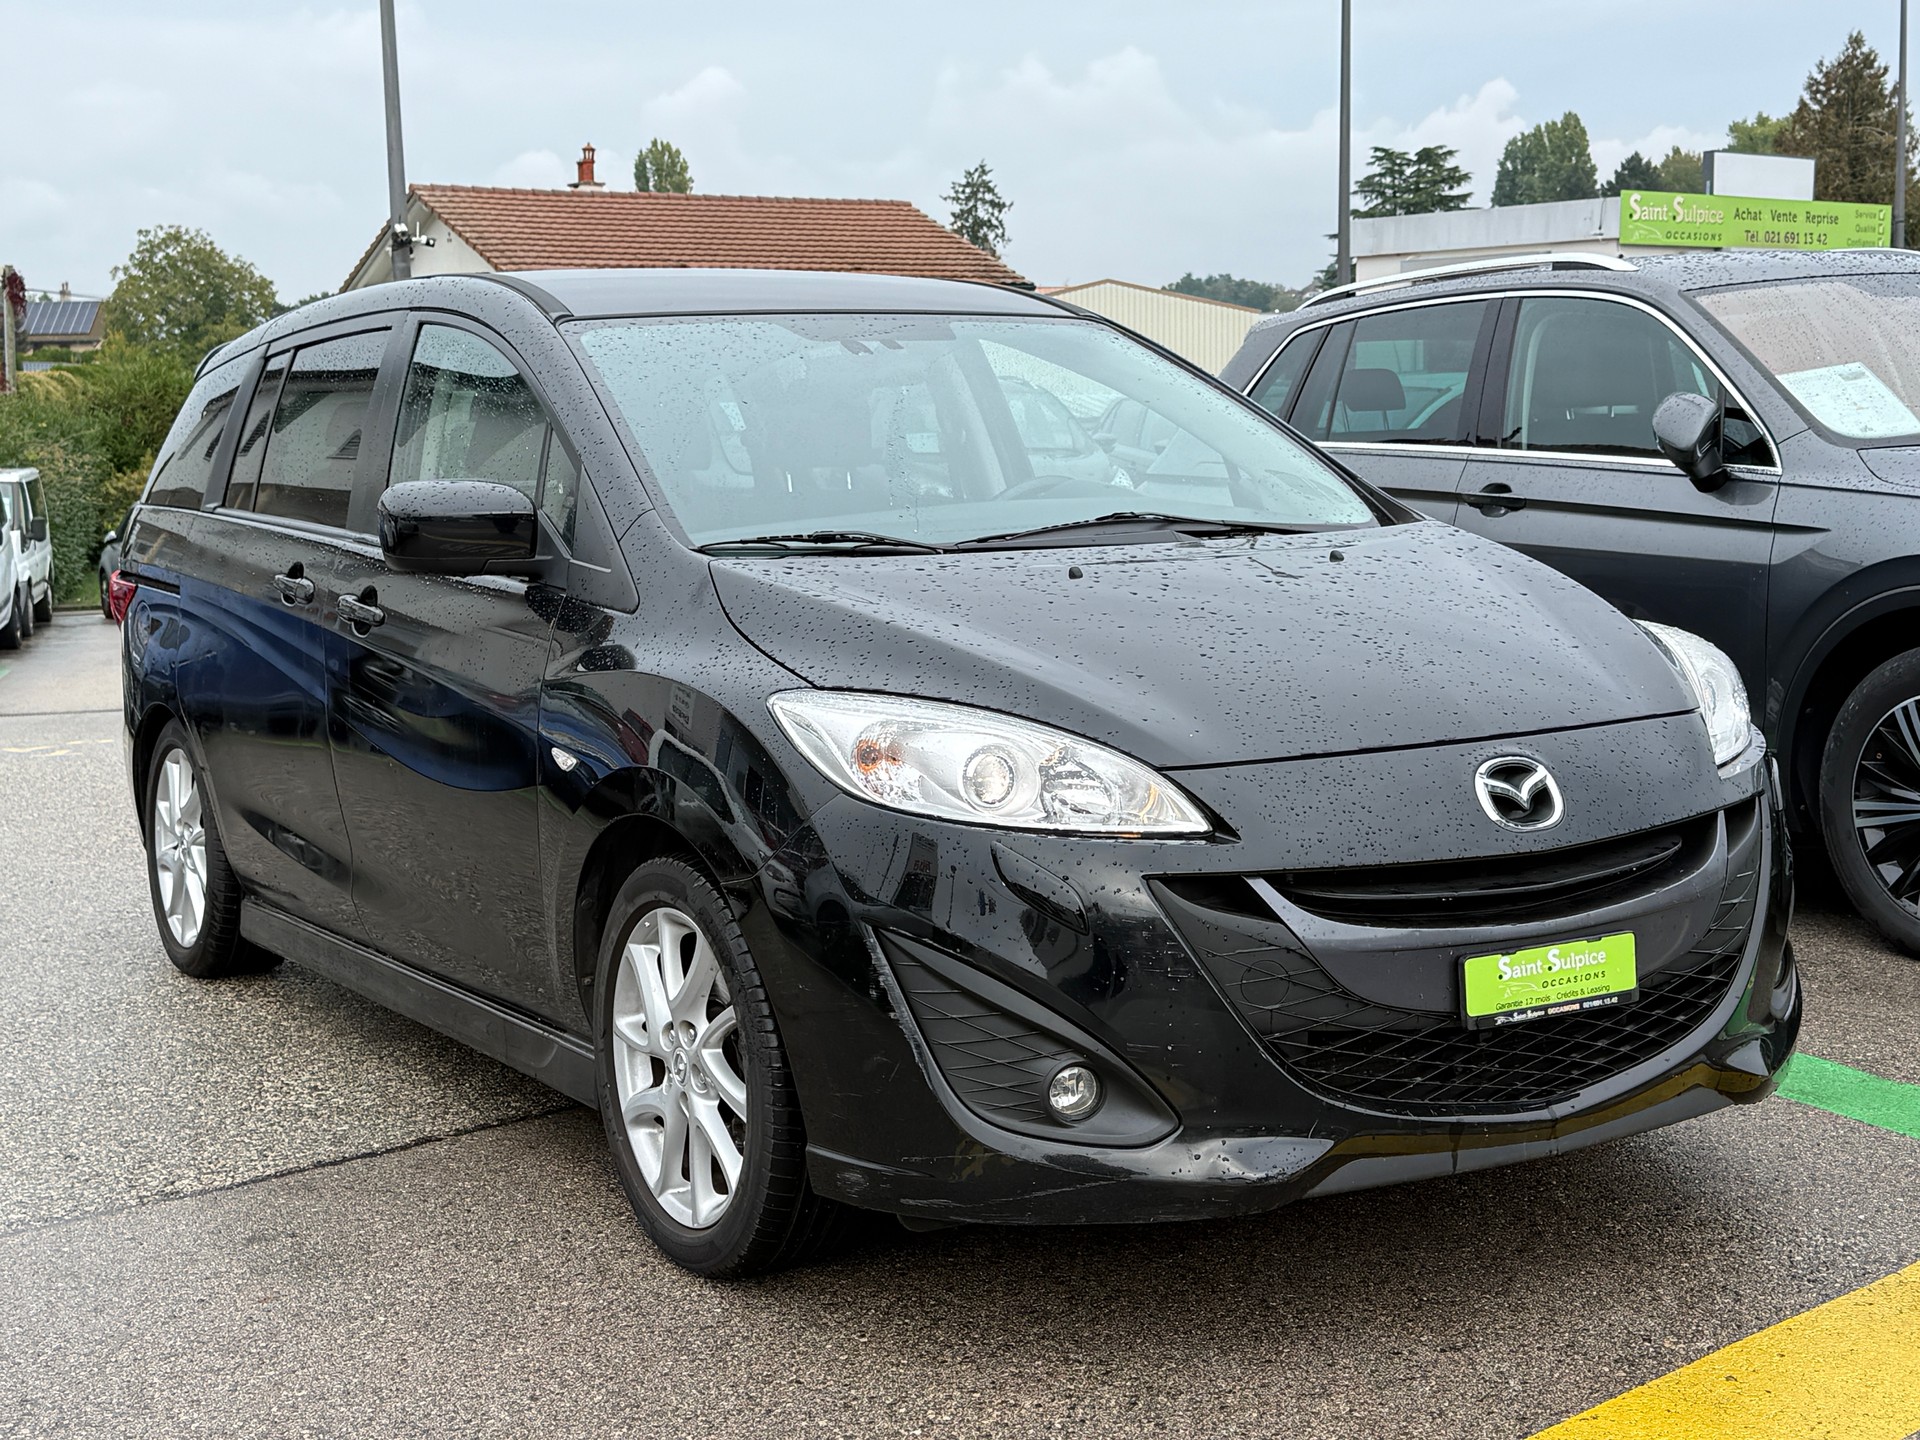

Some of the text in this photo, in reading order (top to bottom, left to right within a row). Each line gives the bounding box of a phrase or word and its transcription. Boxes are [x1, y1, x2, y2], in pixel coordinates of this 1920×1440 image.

[1734, 207, 1839, 227] Achat Vente Reprise
[1665, 230, 1722, 241] OCCASIONS
[1764, 230, 1781, 244] 021
[1784, 231, 1800, 245] 691
[1804, 232, 1814, 245] 13
[1816, 233, 1828, 246] 42
[1541, 970, 1606, 989] OCCASIONS
[1495, 1000, 1523, 1011] Garantie
[1525, 997, 1534, 1006] 12
[1535, 994, 1551, 1005] mois
[1556, 990, 1579, 1001] Crédits
[1586, 983, 1610, 995] Leasing
